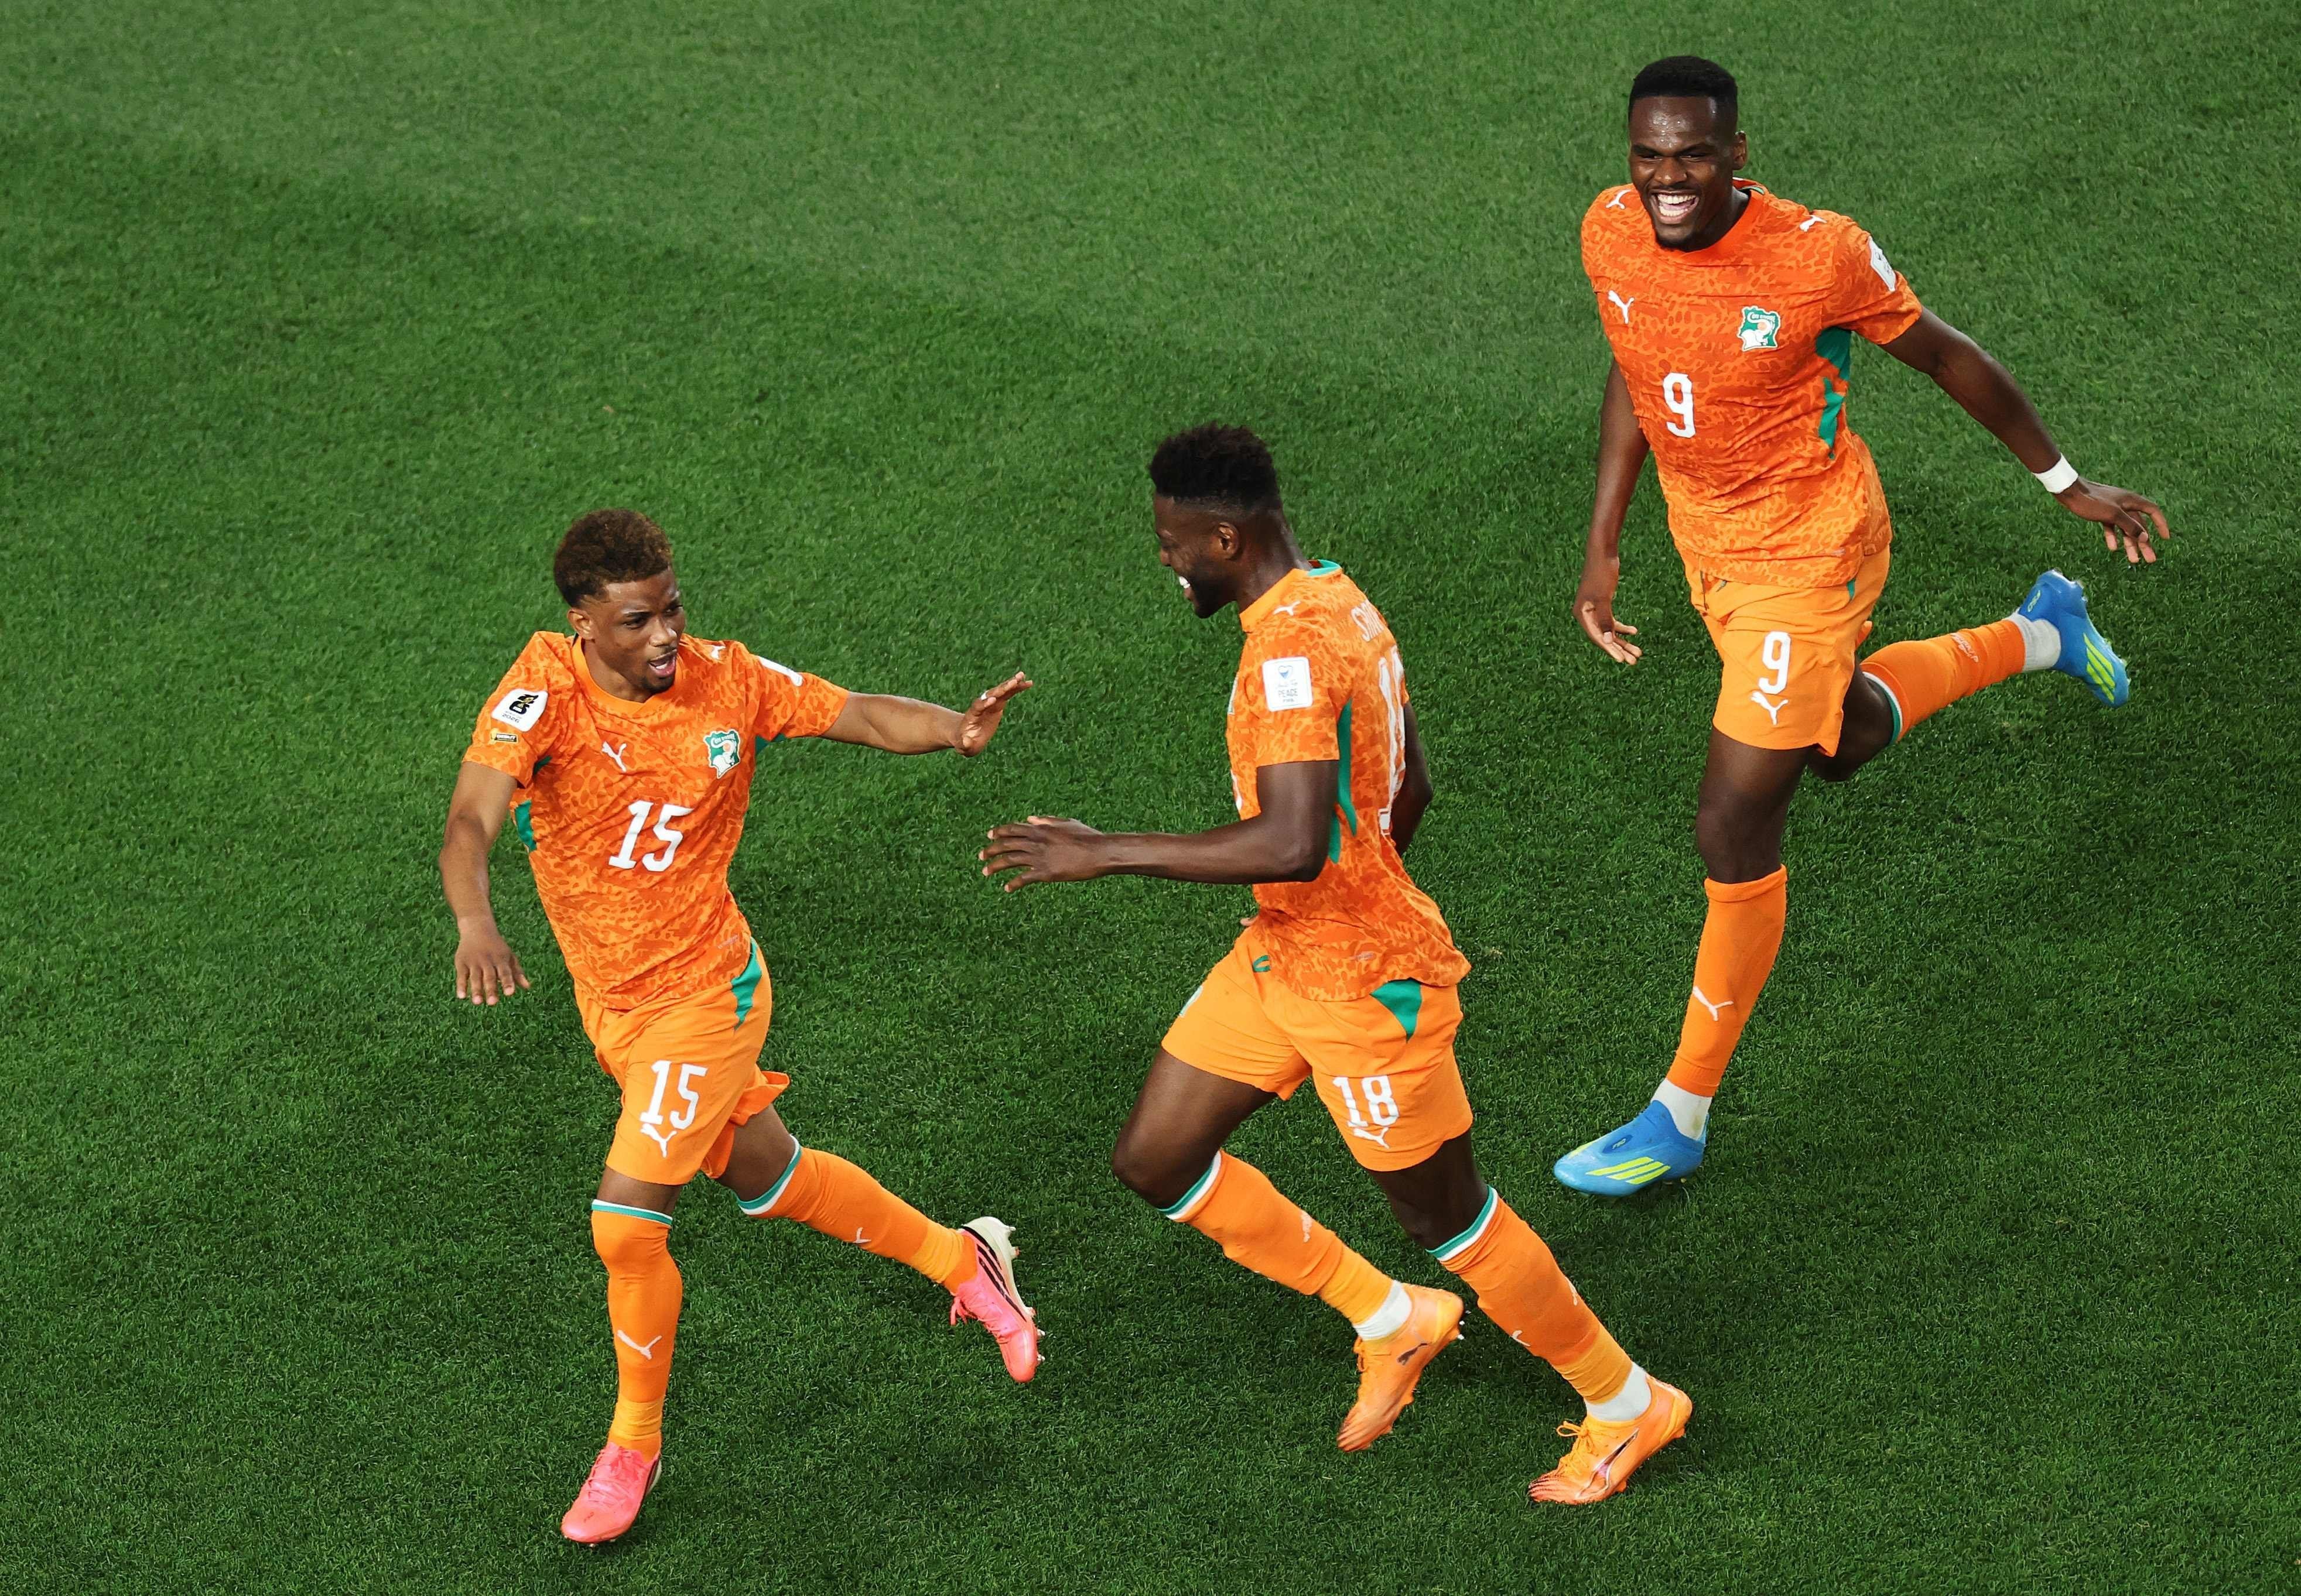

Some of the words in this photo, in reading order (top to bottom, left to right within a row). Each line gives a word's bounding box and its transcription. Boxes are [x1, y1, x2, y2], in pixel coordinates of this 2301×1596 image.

[1662, 372, 1696, 439] 9
[1758, 631, 1791, 695] 9
[608, 800, 693, 872] 15
[639, 1060, 709, 1130] 15
[1332, 1075, 1400, 1127] 18
